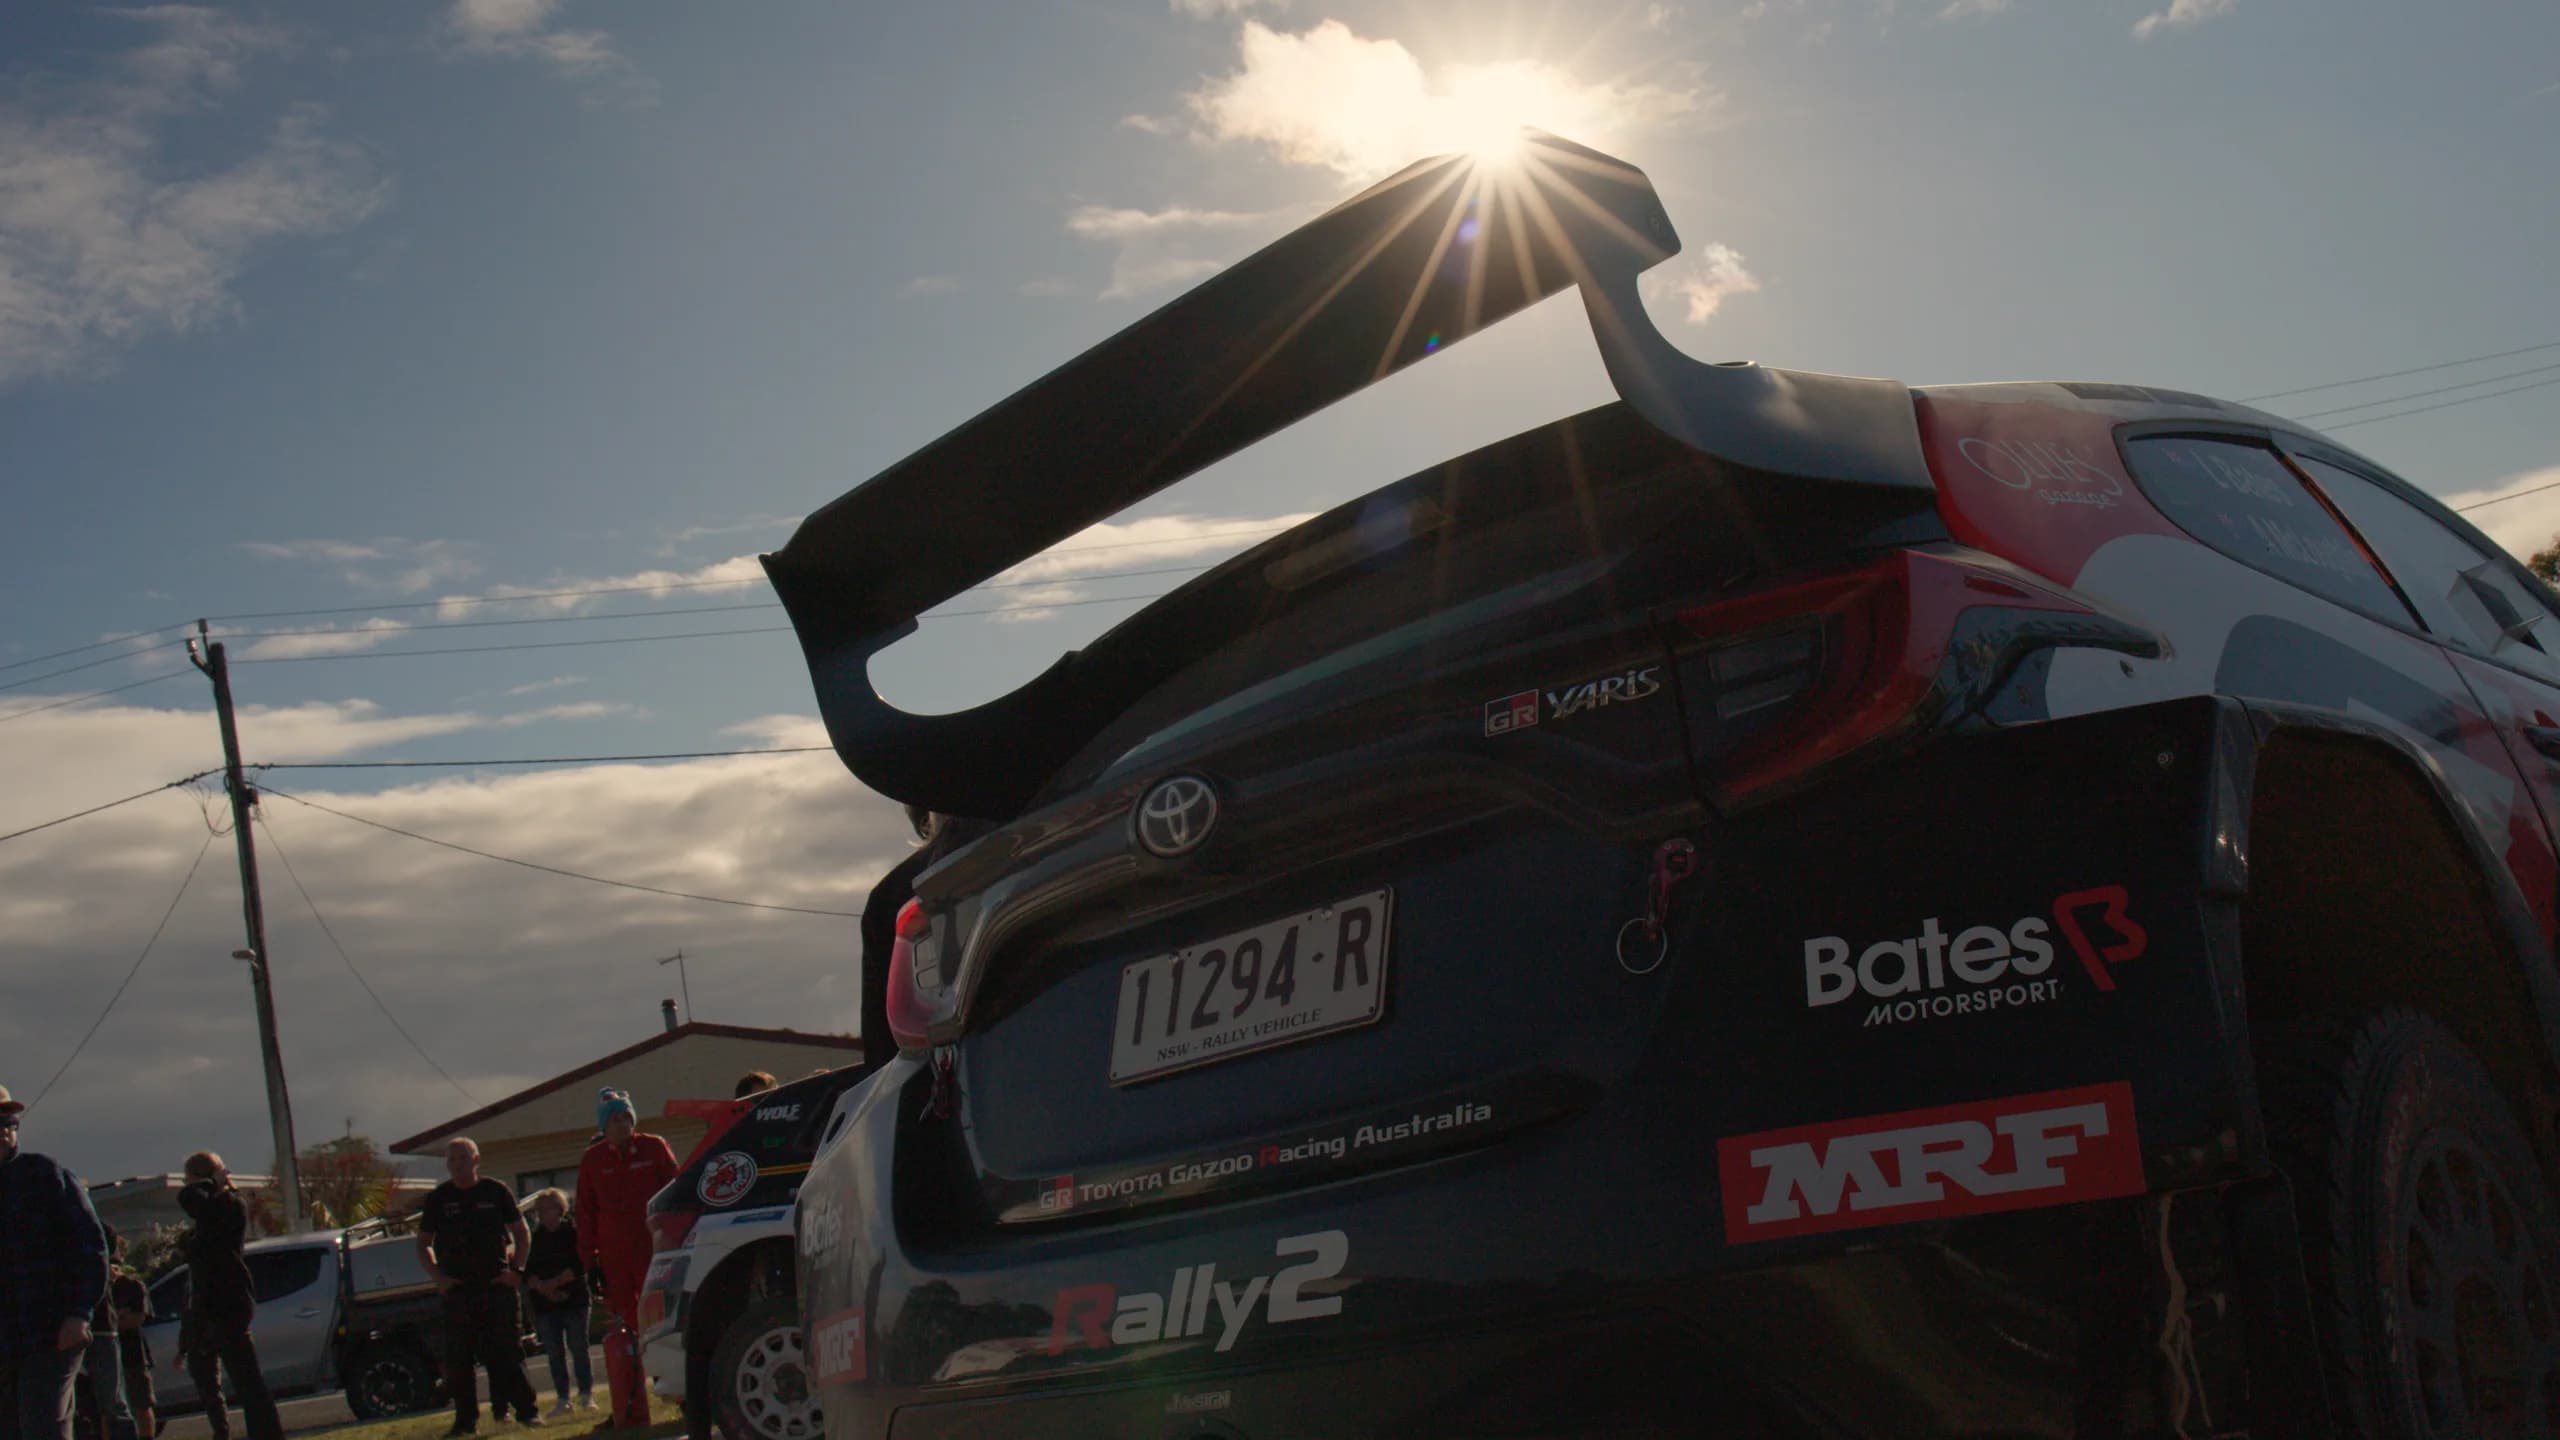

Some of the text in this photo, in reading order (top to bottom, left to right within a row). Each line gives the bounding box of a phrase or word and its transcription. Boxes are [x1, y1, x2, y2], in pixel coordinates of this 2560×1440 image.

[1487, 704, 1536, 734] GR
[1803, 916, 2055, 1008] Bates
[1156, 1042, 1191, 1062] NSW
[1203, 1028, 1249, 1050] RALLY
[1252, 1008, 1322, 1036] VEHICLE
[1863, 977, 2061, 1028] MOTORSPORT
[756, 1104, 801, 1121] WOLF
[1040, 1102, 1493, 1211] GR TOYOTA GAZOO Racing Australia
[1747, 1101, 2109, 1225] MRF
[1046, 1228, 1350, 1357] Rally2
